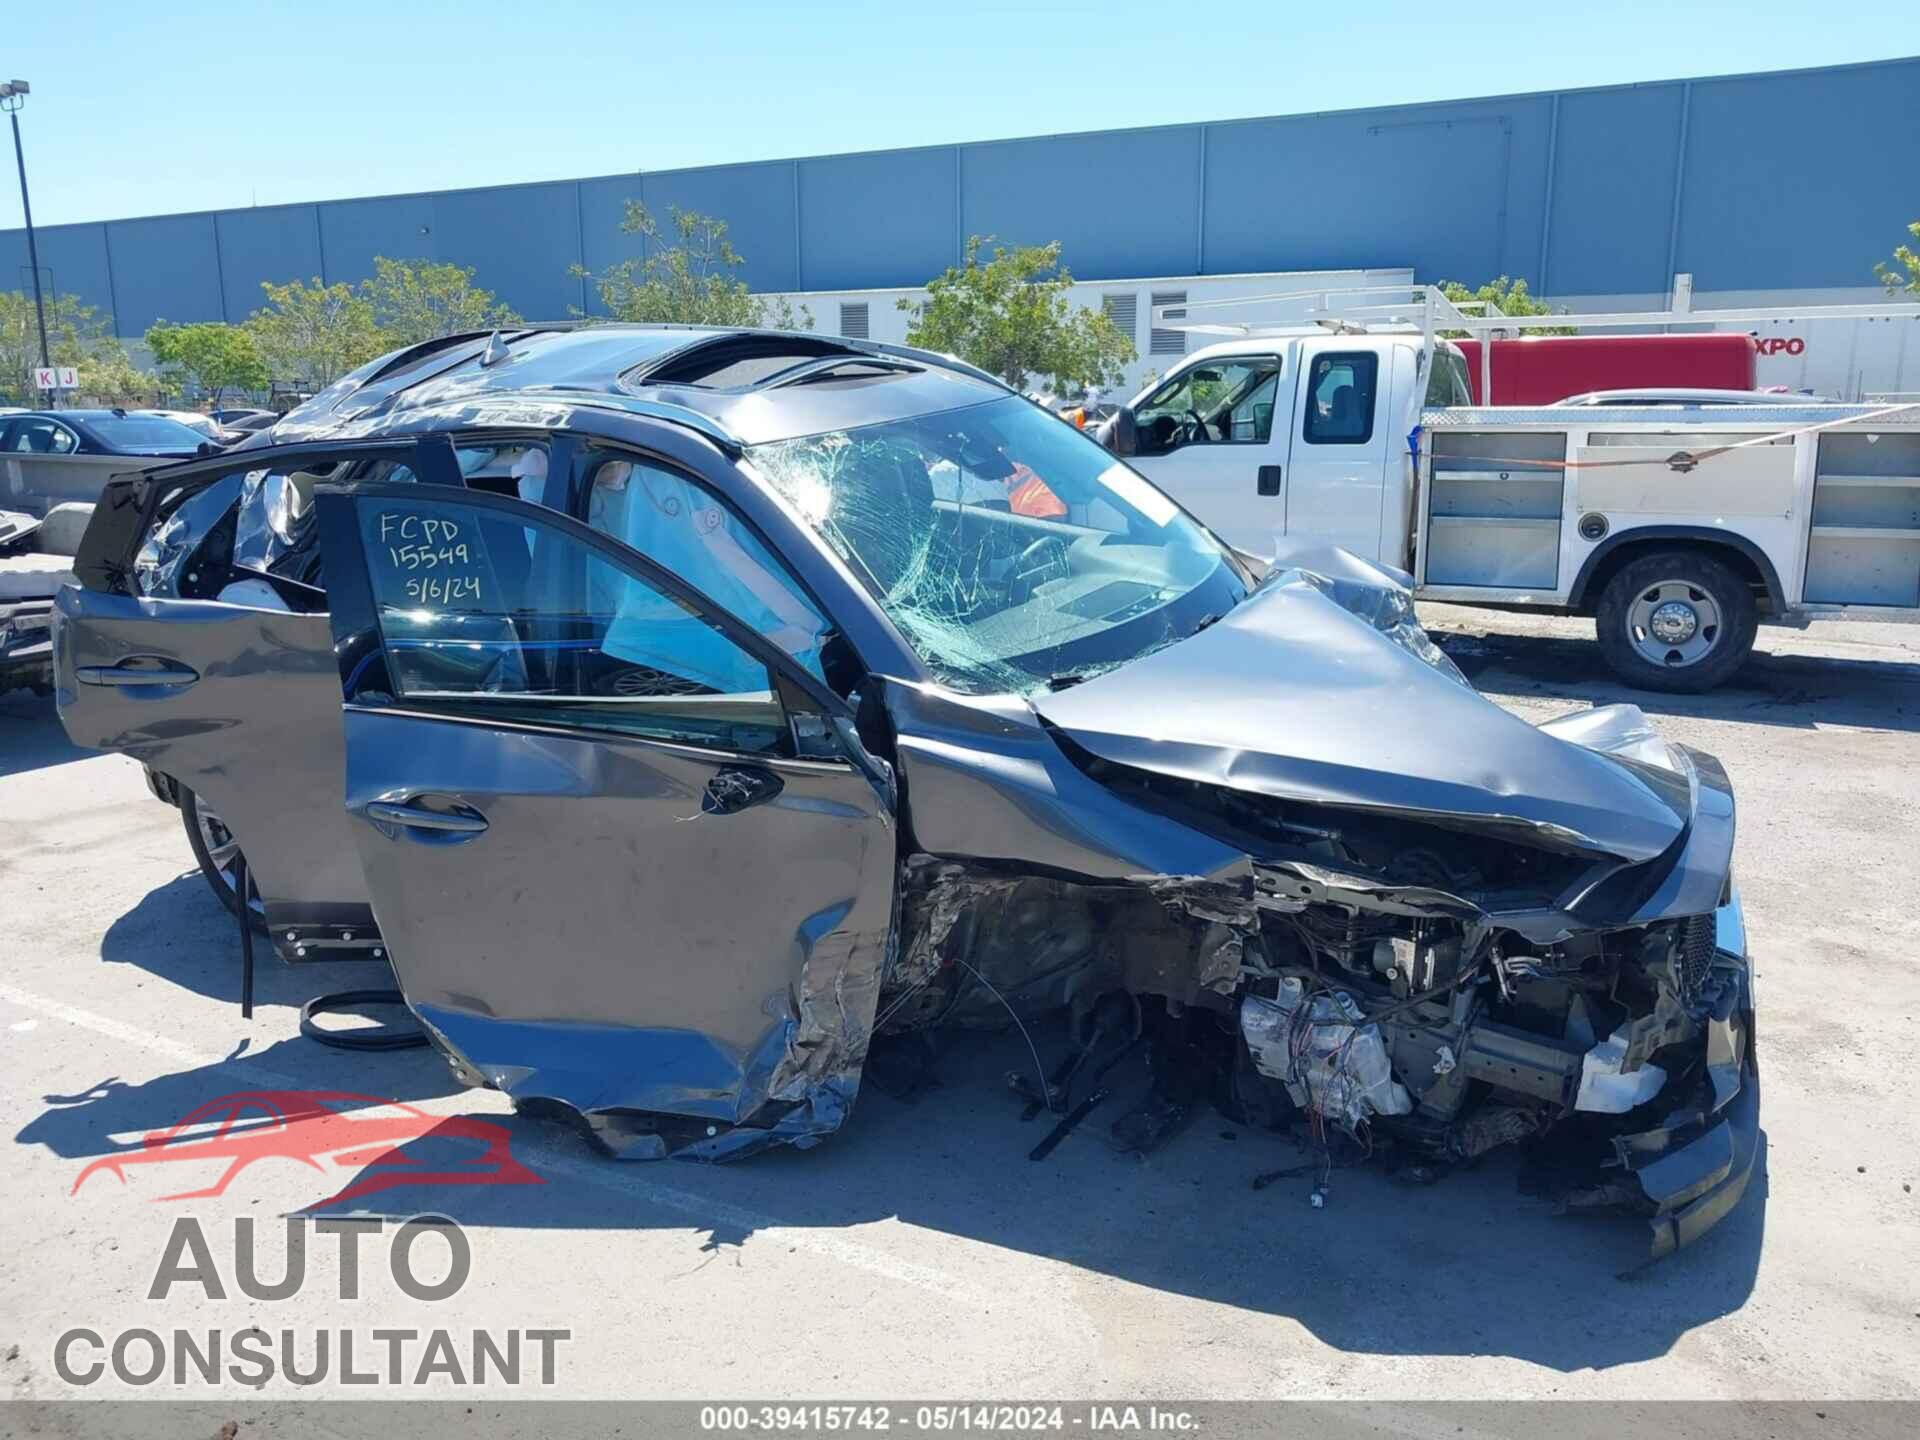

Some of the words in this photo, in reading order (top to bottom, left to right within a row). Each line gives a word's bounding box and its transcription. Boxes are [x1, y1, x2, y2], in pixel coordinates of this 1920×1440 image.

[40, 372, 51, 384] K
[65, 372, 73, 384] J
[381, 514, 458, 544] FCPD
[390, 544, 468, 569] 15549
[406, 577, 480, 603] 5/6/24
